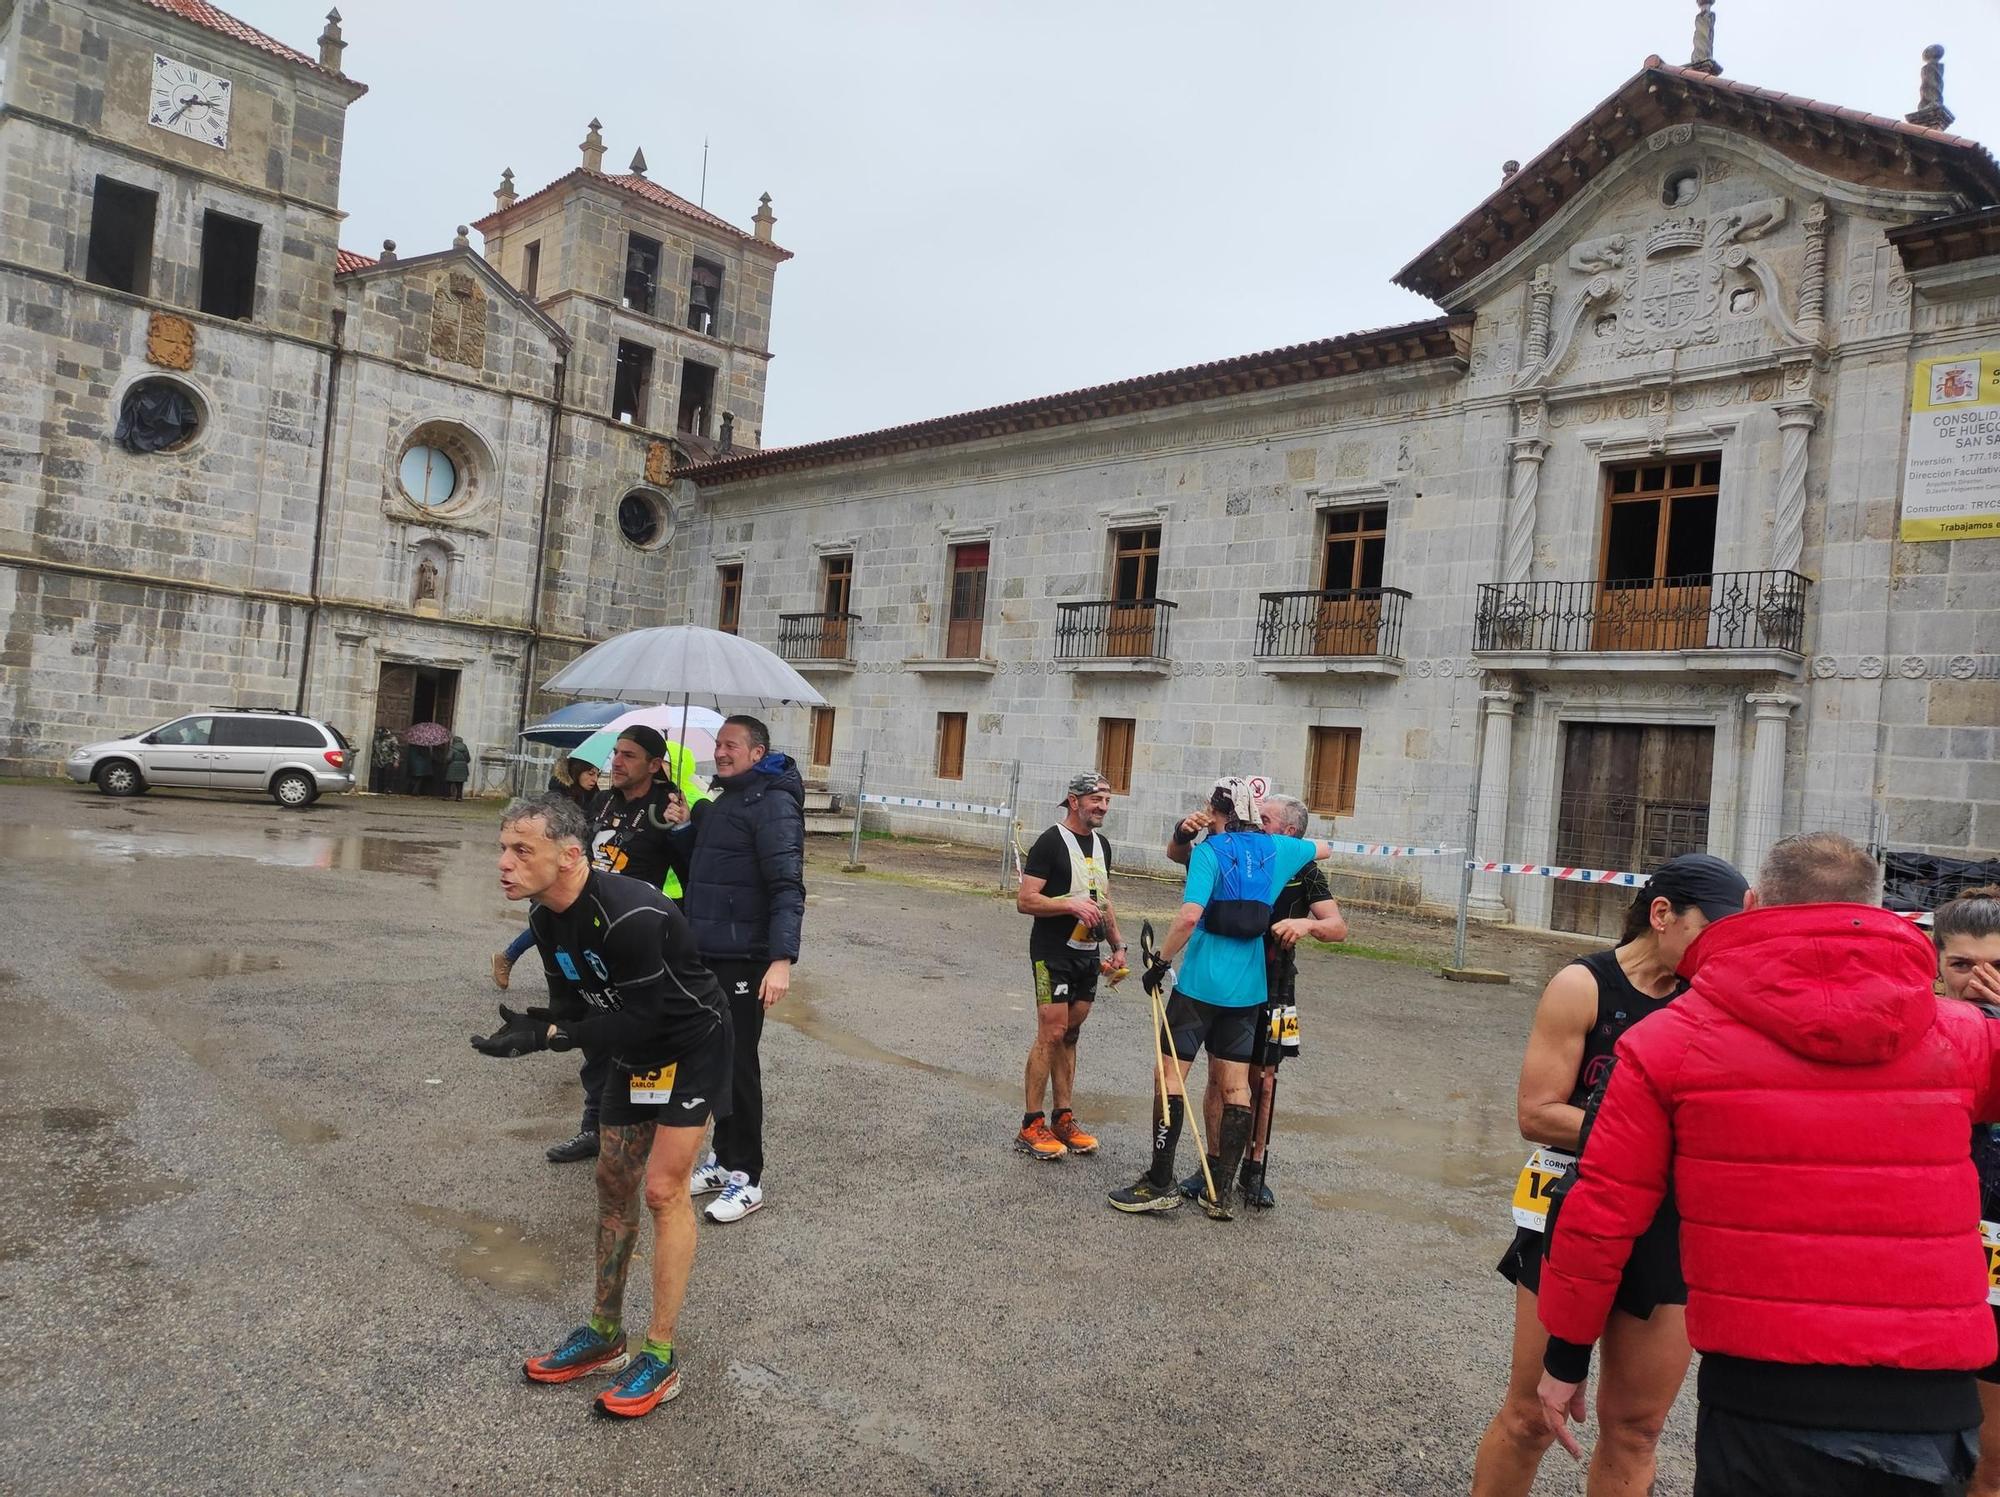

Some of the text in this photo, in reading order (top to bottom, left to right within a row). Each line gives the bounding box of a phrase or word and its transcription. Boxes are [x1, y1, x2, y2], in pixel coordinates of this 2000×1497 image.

[1933, 410, 2000, 427] CONSOLID
[1940, 427, 1957, 438] DE
[1955, 436, 1982, 448] SAN
[1940, 521, 1993, 532] Trabajamos
